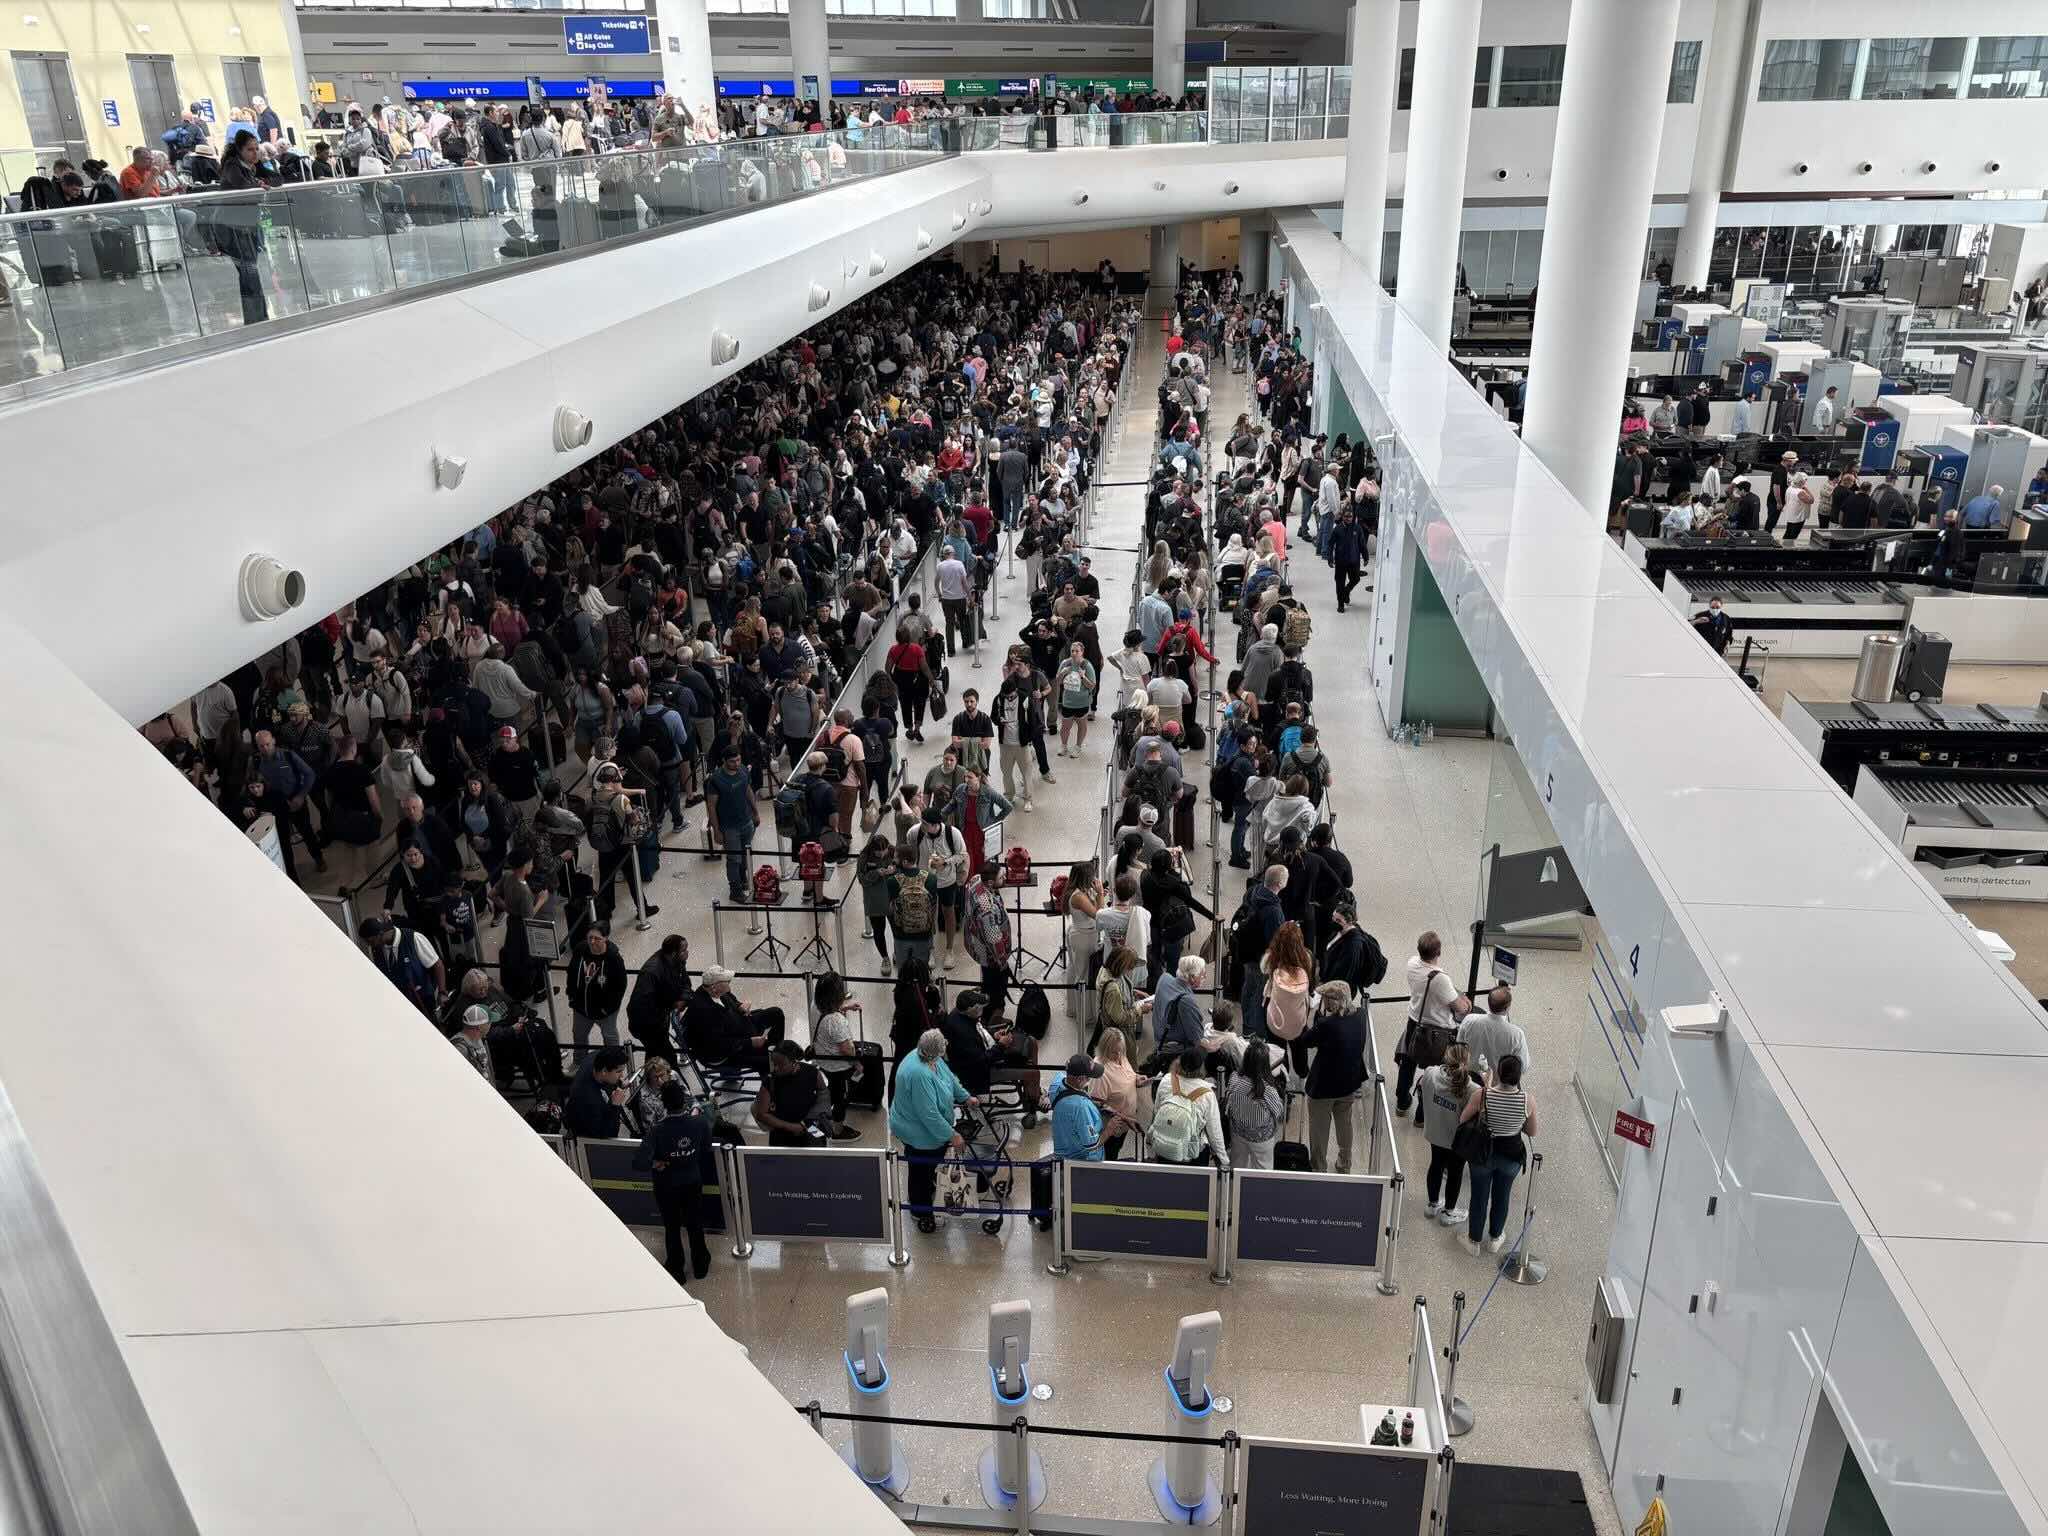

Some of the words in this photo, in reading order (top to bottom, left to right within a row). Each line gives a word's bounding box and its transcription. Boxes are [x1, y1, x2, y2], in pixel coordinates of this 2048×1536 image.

[602, 22, 630, 30] Ticketing
[1546, 772, 1554, 803] 5
[1944, 876, 1979, 884] smiths
[1981, 877, 2031, 886] detection
[1629, 943, 1640, 979] 4
[1616, 1117, 1635, 1130] FIRE
[1114, 1207, 1147, 1216] Welcome
[1301, 1217, 1318, 1225] More
[1280, 1491, 1299, 1500] Less
[1338, 1495, 1360, 1504] More
[1362, 1497, 1388, 1507] Doing
